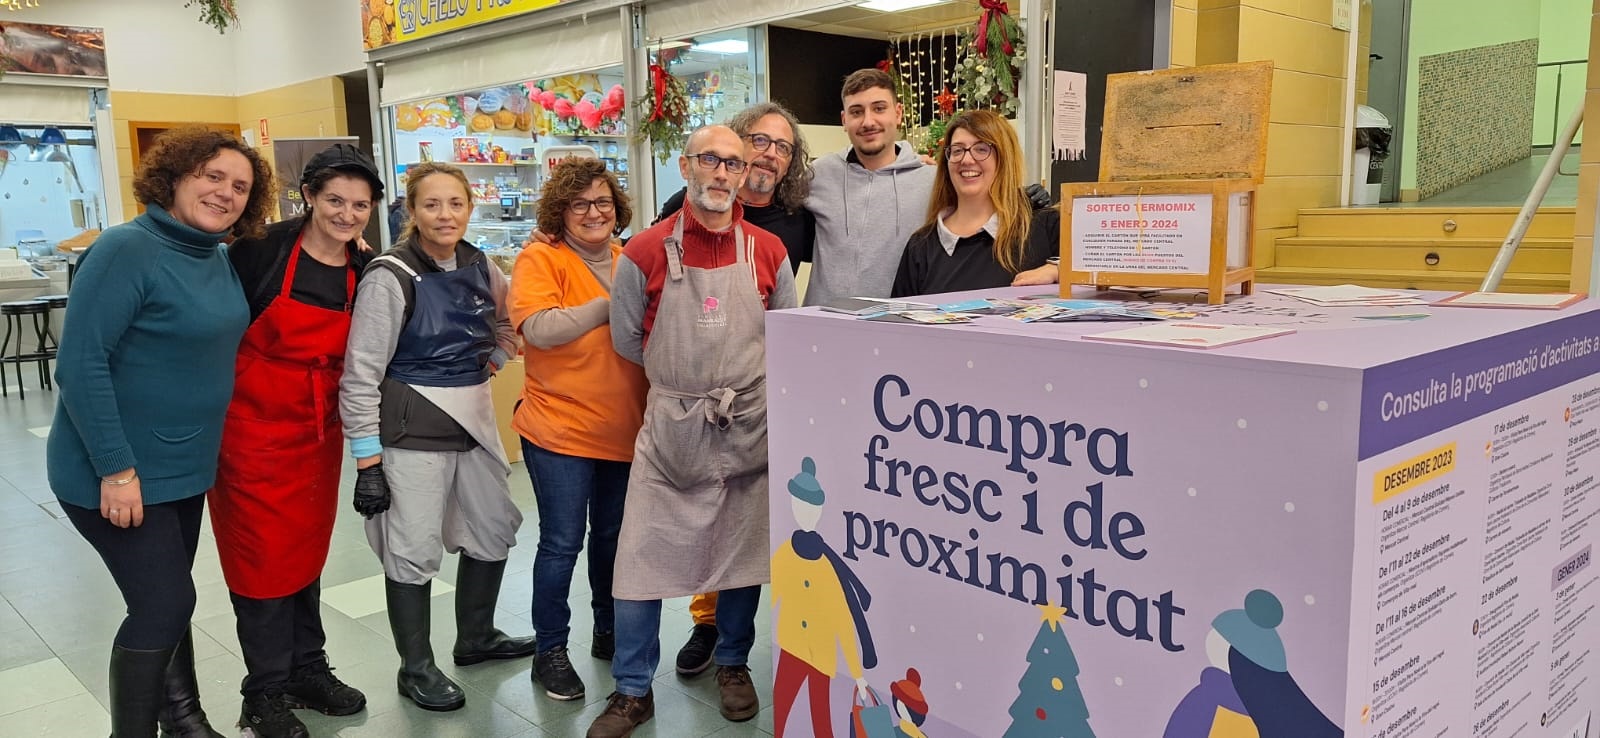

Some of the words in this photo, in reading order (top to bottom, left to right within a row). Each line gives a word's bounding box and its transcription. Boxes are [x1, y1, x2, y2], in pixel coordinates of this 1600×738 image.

[1086, 204, 1130, 212] SORTEO
[1134, 202, 1196, 212] TERMOMIX
[1100, 220, 1107, 228] 5
[1110, 220, 1148, 228] ENERO
[1152, 220, 1178, 228] 2024
[1381, 378, 1447, 422] Consulta
[1450, 372, 1462, 399] la
[1464, 348, 1538, 402] programació
[1540, 336, 1592, 370] d'activitats
[873, 374, 1133, 476] Compra
[1494, 424, 1499, 435] 17
[1499, 421, 1505, 432] de
[1506, 414, 1529, 430] desembre
[1579, 428, 1597, 442] desembre
[1384, 458, 1430, 492] DESEMBRE
[1432, 450, 1452, 471] 2023
[1575, 475, 1593, 488] desembre
[864, 434, 1002, 522] fresc
[1020, 471, 1043, 535] i
[1063, 481, 1149, 560] de
[1383, 506, 1394, 521] Del
[1394, 504, 1399, 515] 4
[1400, 501, 1406, 513] al
[1407, 499, 1411, 510] 9
[1412, 496, 1420, 508] de
[1421, 483, 1449, 504] desembre
[1379, 567, 1388, 578] De
[1398, 556, 1404, 568] al
[1405, 551, 1412, 564] 22
[1413, 548, 1420, 560] de
[1422, 533, 1450, 555] desembre
[1558, 560, 1576, 582] GENER
[842, 510, 1186, 652] proximitat
[1488, 588, 1494, 600] de
[1495, 575, 1518, 596] desembre
[1376, 623, 1384, 635] De
[1394, 610, 1400, 623] al
[1401, 606, 1407, 619] 16
[1409, 602, 1416, 614] de
[1418, 585, 1446, 608] desembre
[1373, 680, 1380, 693] 15
[1380, 676, 1388, 688] de
[1390, 655, 1420, 681] desembre
[1386, 706, 1417, 734] desembre
[1480, 719, 1486, 729] de
[1487, 699, 1510, 721] desembre
